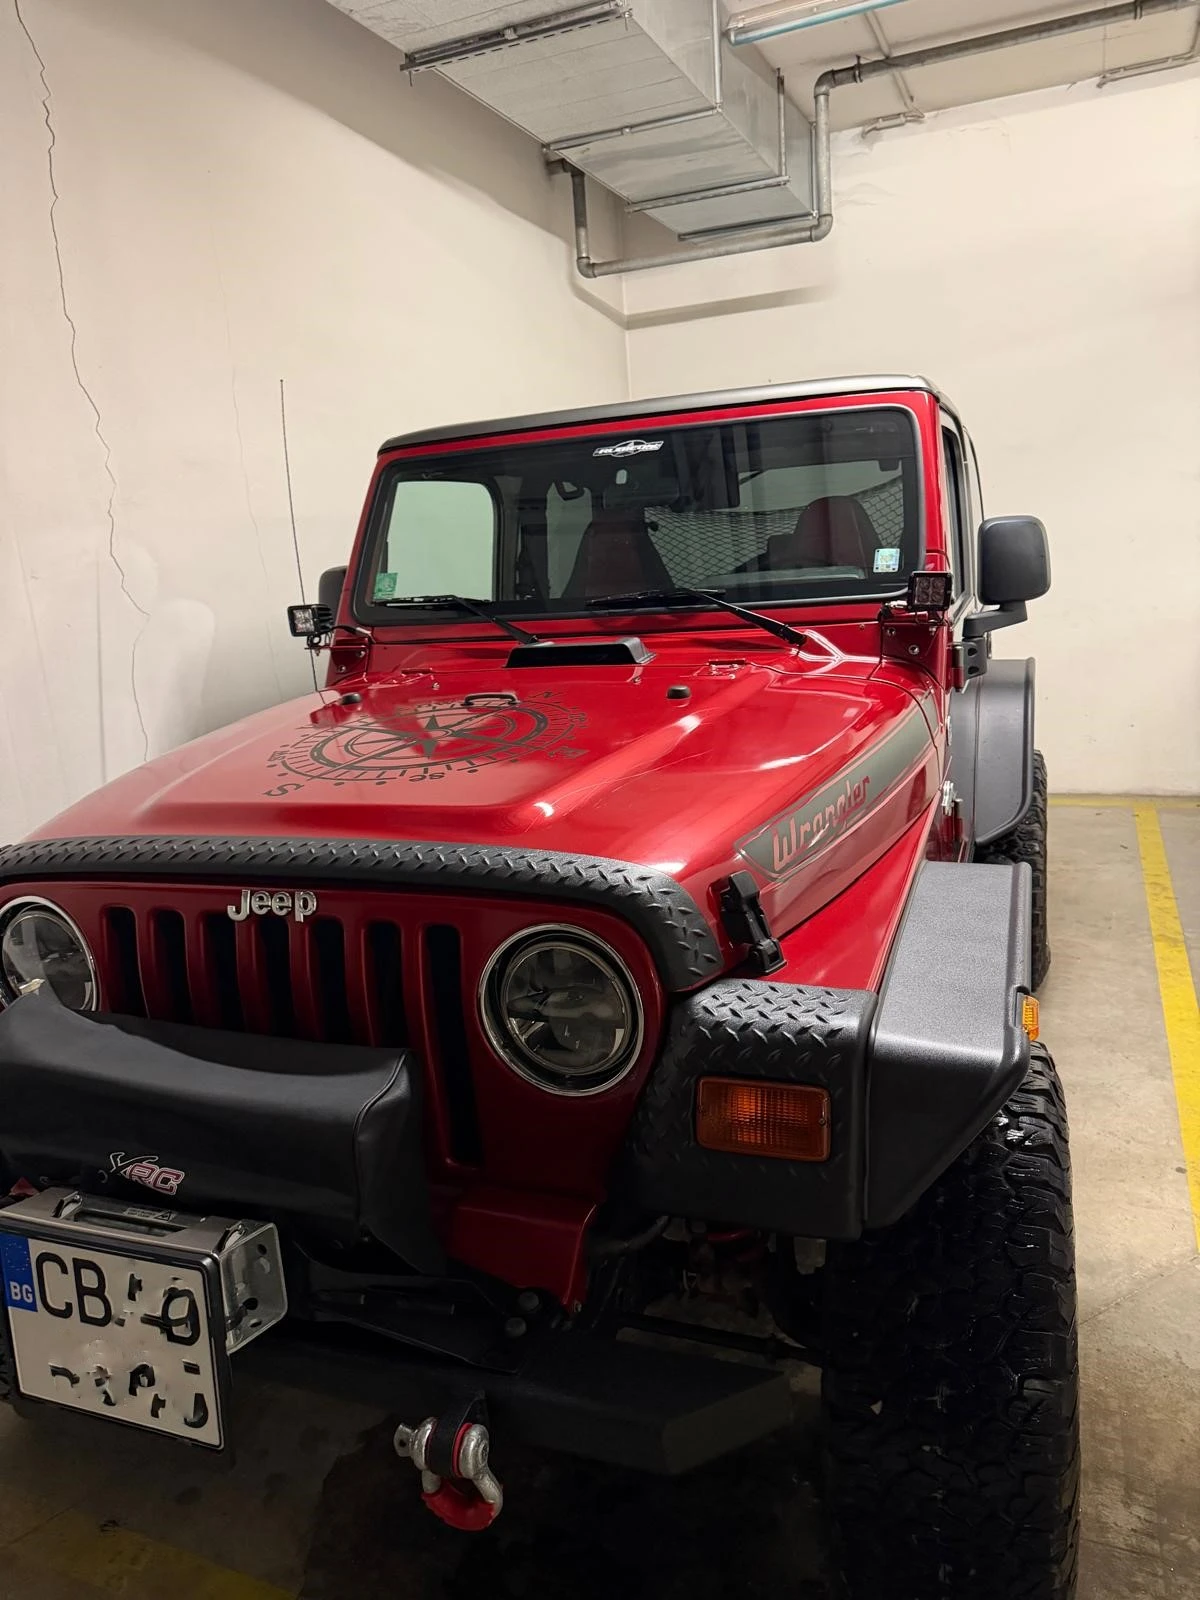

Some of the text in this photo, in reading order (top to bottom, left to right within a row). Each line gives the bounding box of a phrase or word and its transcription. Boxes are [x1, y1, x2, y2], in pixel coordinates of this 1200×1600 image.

[772, 775, 871, 871] Wrangler
[227, 889, 317, 923] Jeep
[9, 1281, 33, 1303] BG
